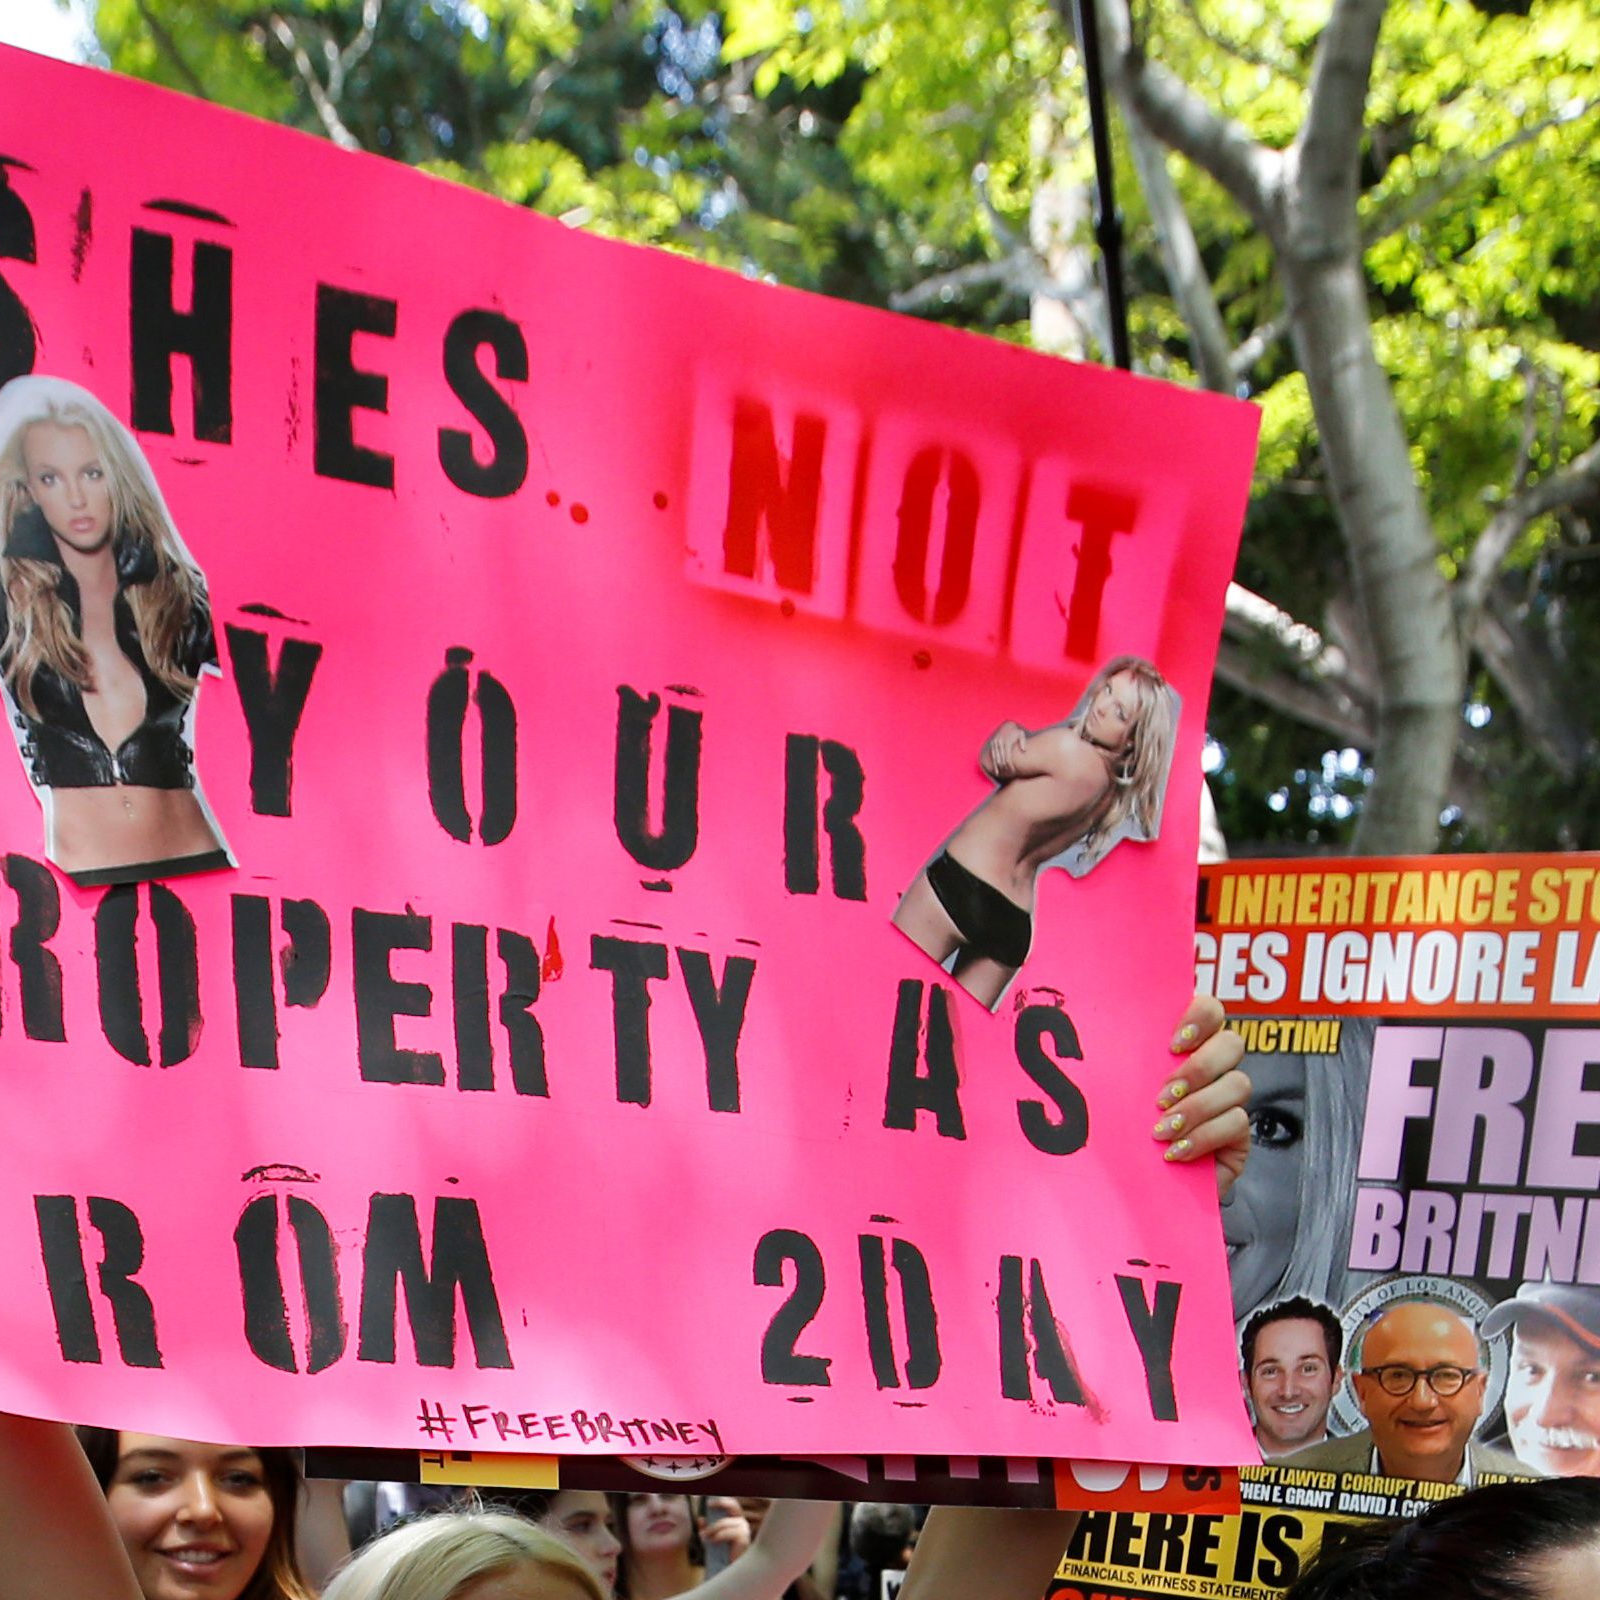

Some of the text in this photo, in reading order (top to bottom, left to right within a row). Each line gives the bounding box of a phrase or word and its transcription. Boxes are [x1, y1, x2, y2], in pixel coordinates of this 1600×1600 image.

[723, 398, 1139, 662] NOT
[225, 620, 869, 903] YOUR
[1217, 868, 1518, 926] INHERITANCE
[1299, 930, 1541, 1005] IGNORE
[881, 980, 1091, 1156] AS
[1377, 1283, 1398, 1301] OF
[1406, 1279, 1439, 1292] LOS
[751, 1220, 1183, 1422] 2DAY
[415, 1398, 728, 1455] #FREEBRITNEY
[1279, 1467, 1337, 1490] LAWYER
[1340, 1472, 1415, 1498] CORRUPT
[1285, 1488, 1335, 1510] GRANT
[1337, 1493, 1387, 1515] DAVID
[1063, 1562, 1138, 1586] FINANCIALS,
[1141, 1574, 1197, 1592] WITNESS
